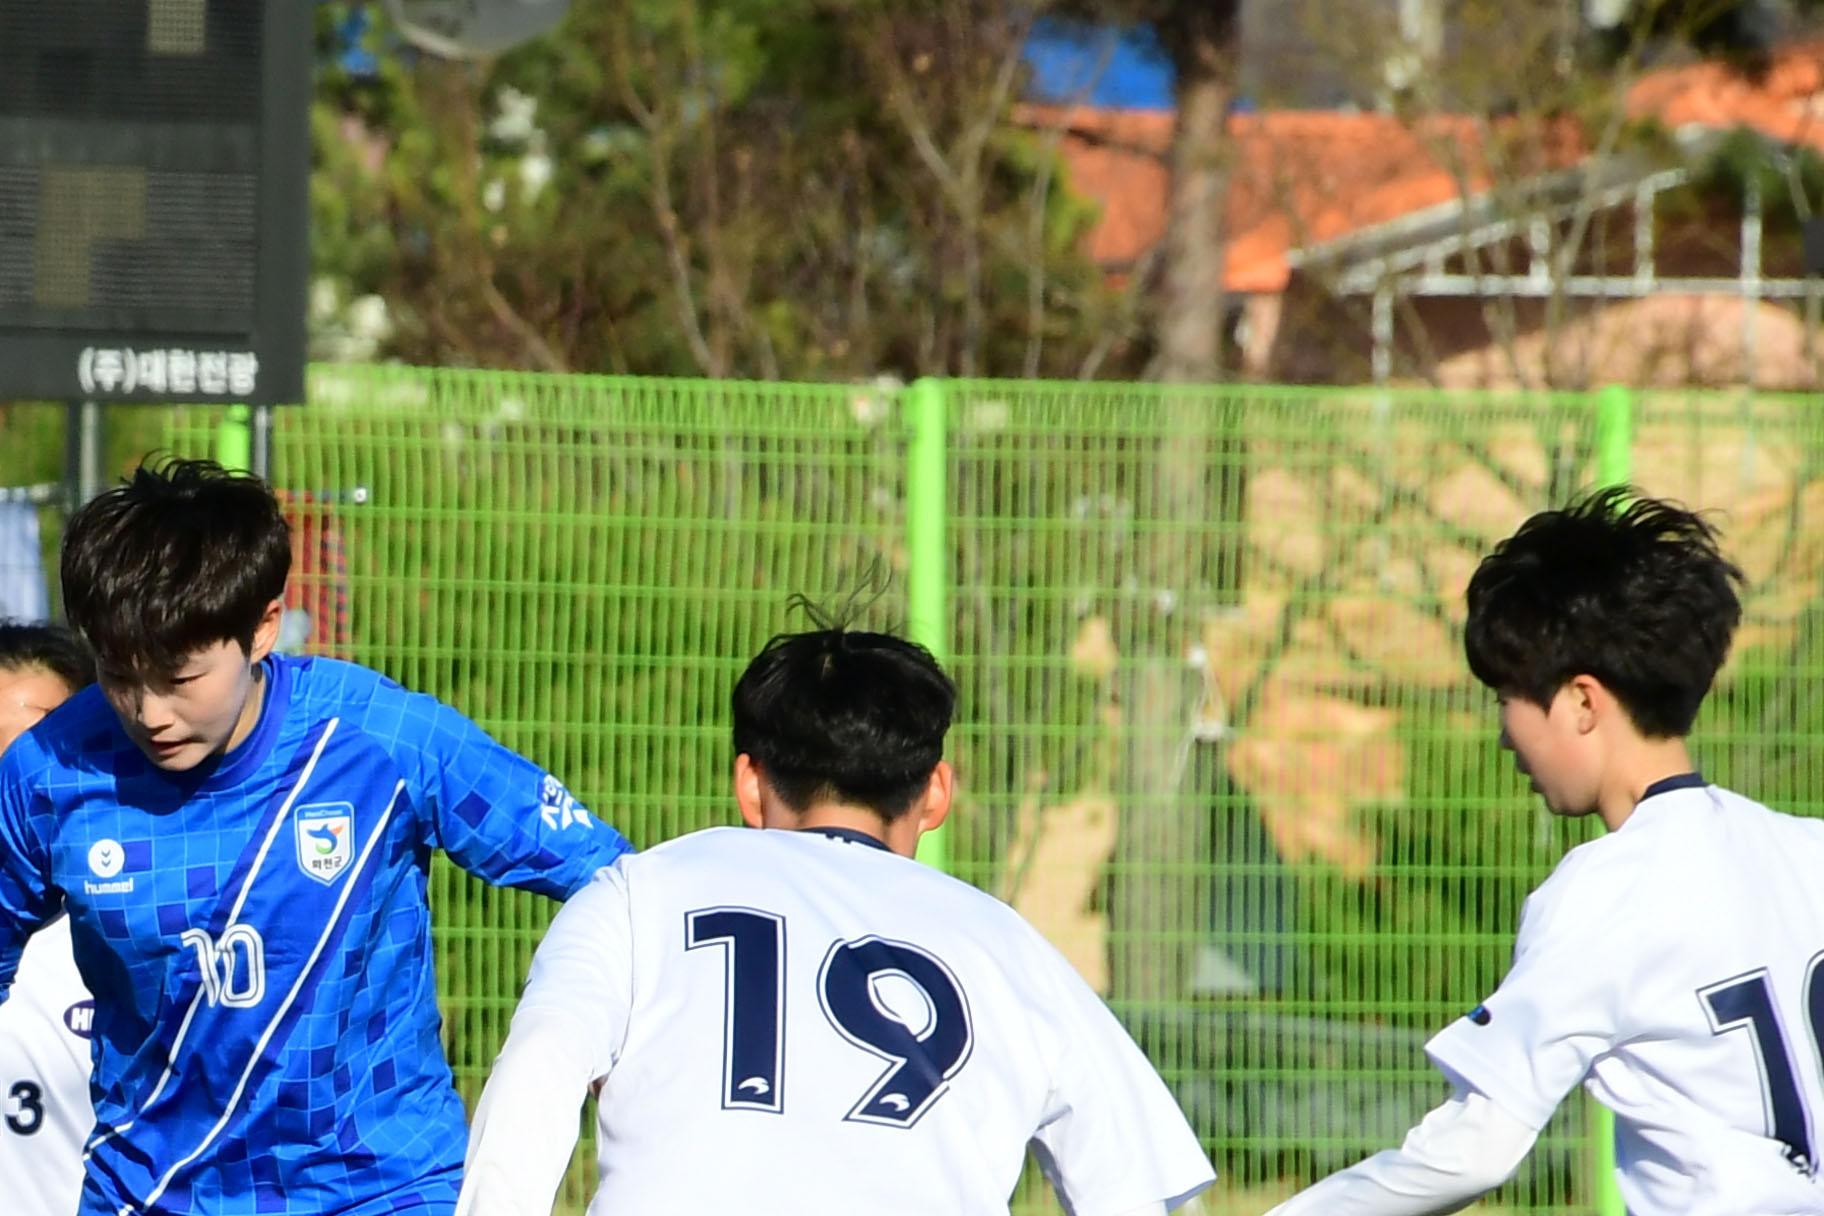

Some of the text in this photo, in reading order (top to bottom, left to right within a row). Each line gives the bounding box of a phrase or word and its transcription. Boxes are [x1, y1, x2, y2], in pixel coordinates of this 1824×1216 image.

[83, 877, 134, 895] hummel
[180, 923, 266, 1009] 10
[683, 906, 975, 1129] 19
